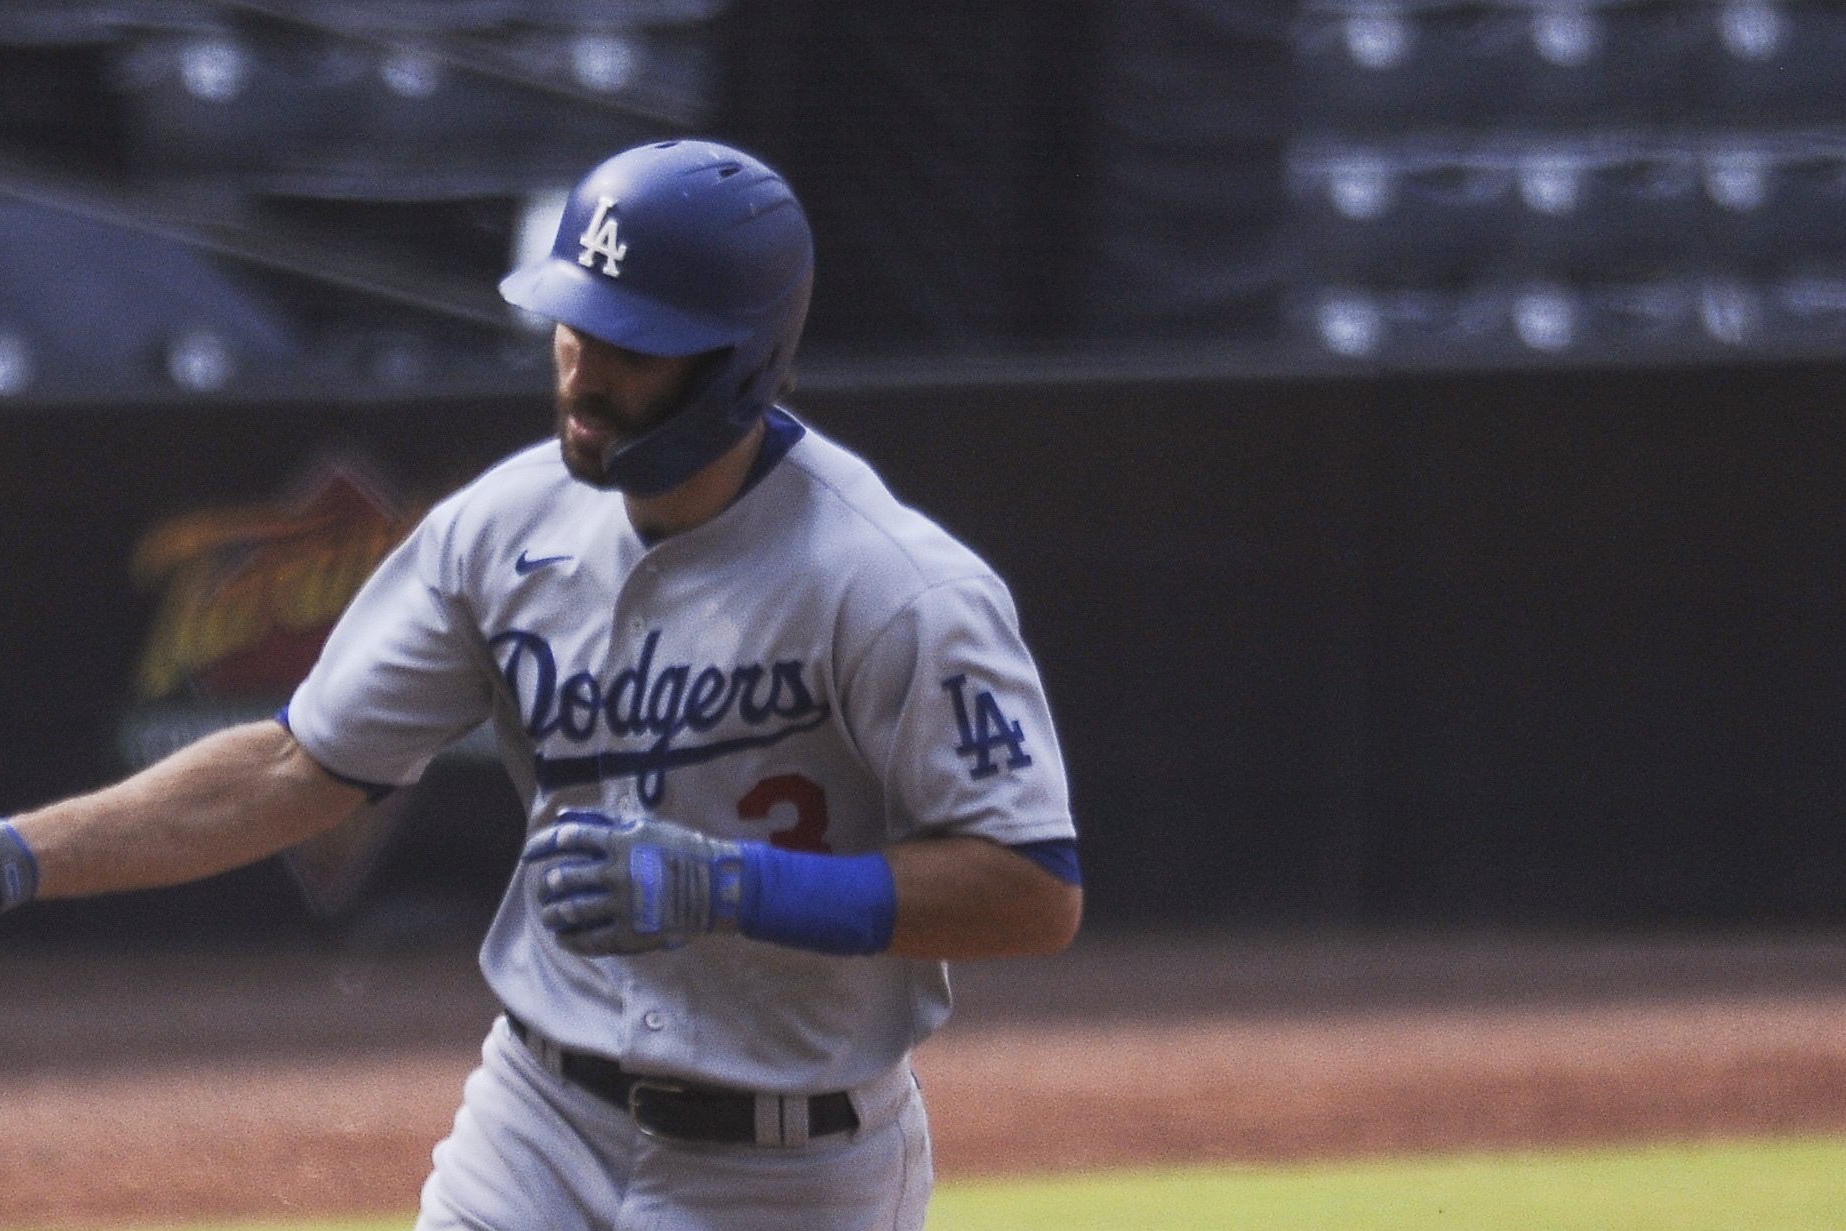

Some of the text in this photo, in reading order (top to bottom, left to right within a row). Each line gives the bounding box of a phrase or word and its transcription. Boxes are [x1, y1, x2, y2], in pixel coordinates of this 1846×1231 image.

[579, 197, 627, 278] LA
[488, 628, 830, 810] Dodgers
[942, 673, 1032, 780] LA
